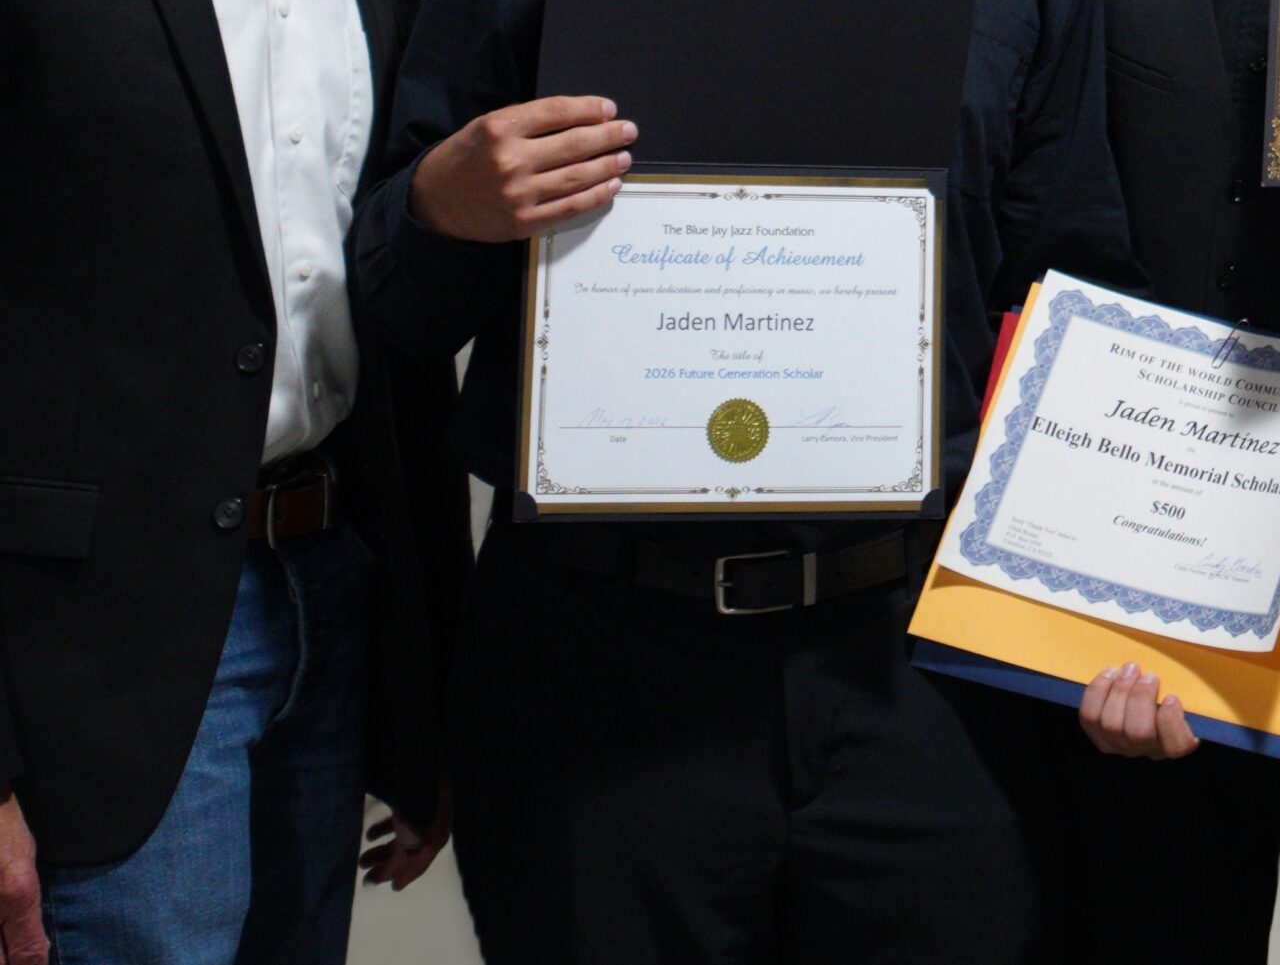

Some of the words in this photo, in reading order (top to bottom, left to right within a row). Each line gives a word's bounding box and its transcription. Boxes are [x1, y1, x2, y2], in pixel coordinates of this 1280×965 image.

[663, 224, 683, 235] The
[685, 225, 709, 235] Blue
[711, 225, 728, 238] Jay
[730, 225, 753, 237] Jazz
[756, 226, 815, 237] Foundation
[611, 243, 713, 271] Certificate
[714, 245, 736, 271] of
[742, 245, 865, 267] Achievement
[591, 283, 618, 294] honor
[619, 283, 631, 297] of
[632, 287, 653, 297] your
[655, 284, 701, 294] dedication
[704, 284, 721, 294] and
[722, 284, 773, 298] proficiency
[776, 286, 785, 295] in
[833, 285, 863, 298] hereby
[864, 287, 897, 298] present
[656, 311, 716, 331] Jaden
[724, 312, 815, 332] Martinez
[710, 349, 730, 360] The
[732, 350, 751, 361] title
[753, 350, 764, 364] of
[1109, 342, 1136, 360] RIM
[1138, 353, 1156, 366] OF
[1159, 358, 1184, 374] THE
[1187, 366, 1232, 387] WORLD
[644, 368, 676, 379] 2026
[679, 368, 715, 379] Future
[718, 368, 780, 379] Generation
[783, 368, 824, 379] Scholar
[1137, 368, 1226, 402] SCHOLARSHIP
[1228, 393, 1280, 413] COUNCIL
[1104, 399, 1176, 432] Jaden
[610, 435, 627, 443] Date
[801, 435, 819, 444] Larry
[865, 435, 898, 443] President
[1030, 415, 1093, 450] Elleigh
[1097, 437, 1141, 464] Bello
[1145, 452, 1229, 487] Memorial
[1150, 500, 1187, 521] $500
[1113, 514, 1208, 548] Congratulations!
